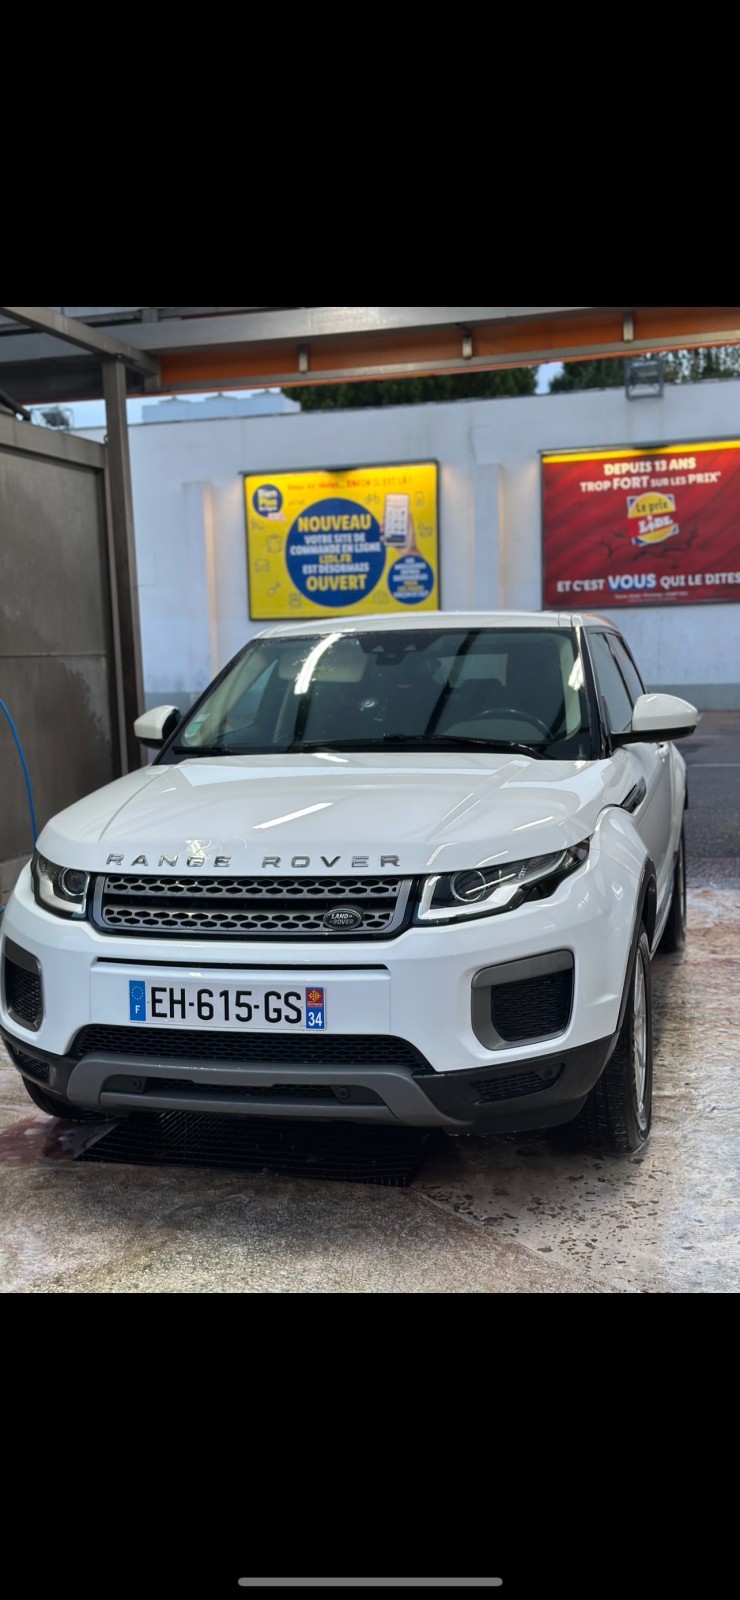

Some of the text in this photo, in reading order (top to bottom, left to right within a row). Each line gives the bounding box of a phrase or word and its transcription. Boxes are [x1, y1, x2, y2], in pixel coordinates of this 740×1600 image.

[603, 457, 697, 476] DEPUIS 13 ANS
[580, 481, 611, 492] TROP
[612, 475, 650, 490] FORT
[651, 479, 669, 488] SUR
[670, 476, 687, 486] LES
[635, 500, 669, 515] Le prix
[297, 514, 372, 533] NOUVEAU
[304, 534, 333, 545] VOTRE
[353, 532, 366, 543] DE
[289, 541, 381, 556] COMMANDE EN LIGNE
[305, 573, 367, 592] OUVERT
[556, 571, 740, 592] ET C'EST VOUS QUI LE DITES
[105, 853, 400, 868] RANGE ROVER
[135, 1004, 141, 1014] F
[150, 986, 302, 1024] EH-615-GS
[308, 1011, 323, 1027] 34
